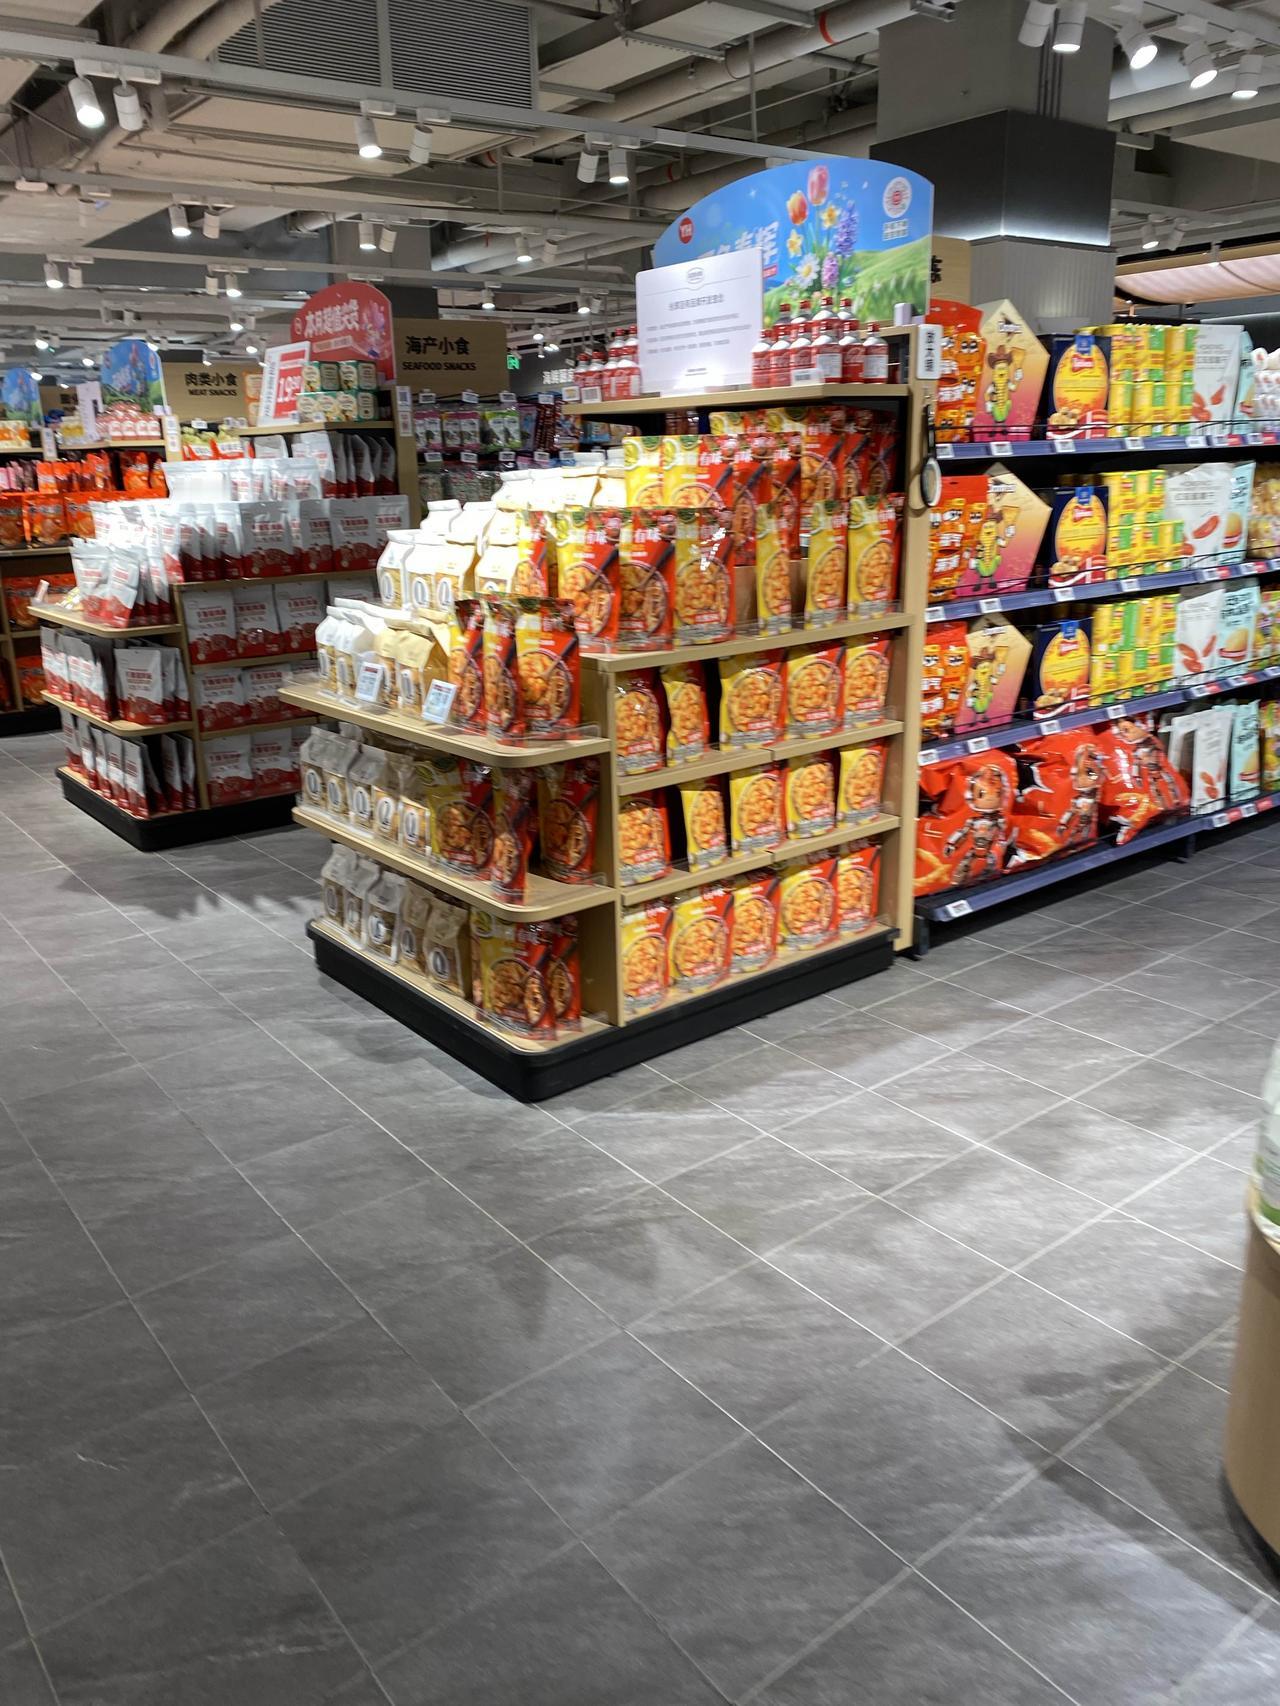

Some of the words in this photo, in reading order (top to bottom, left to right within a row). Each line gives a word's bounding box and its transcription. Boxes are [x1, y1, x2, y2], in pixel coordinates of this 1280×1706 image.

[405, 336, 470, 356] 海产小食
[402, 361, 441, 371] SEAFOOD
[444, 361, 476, 371] SNACKS
[185, 373, 239, 387] 肉类小食
[188, 389, 207, 397] MEAT
[209, 389, 238, 397] SNACKS
